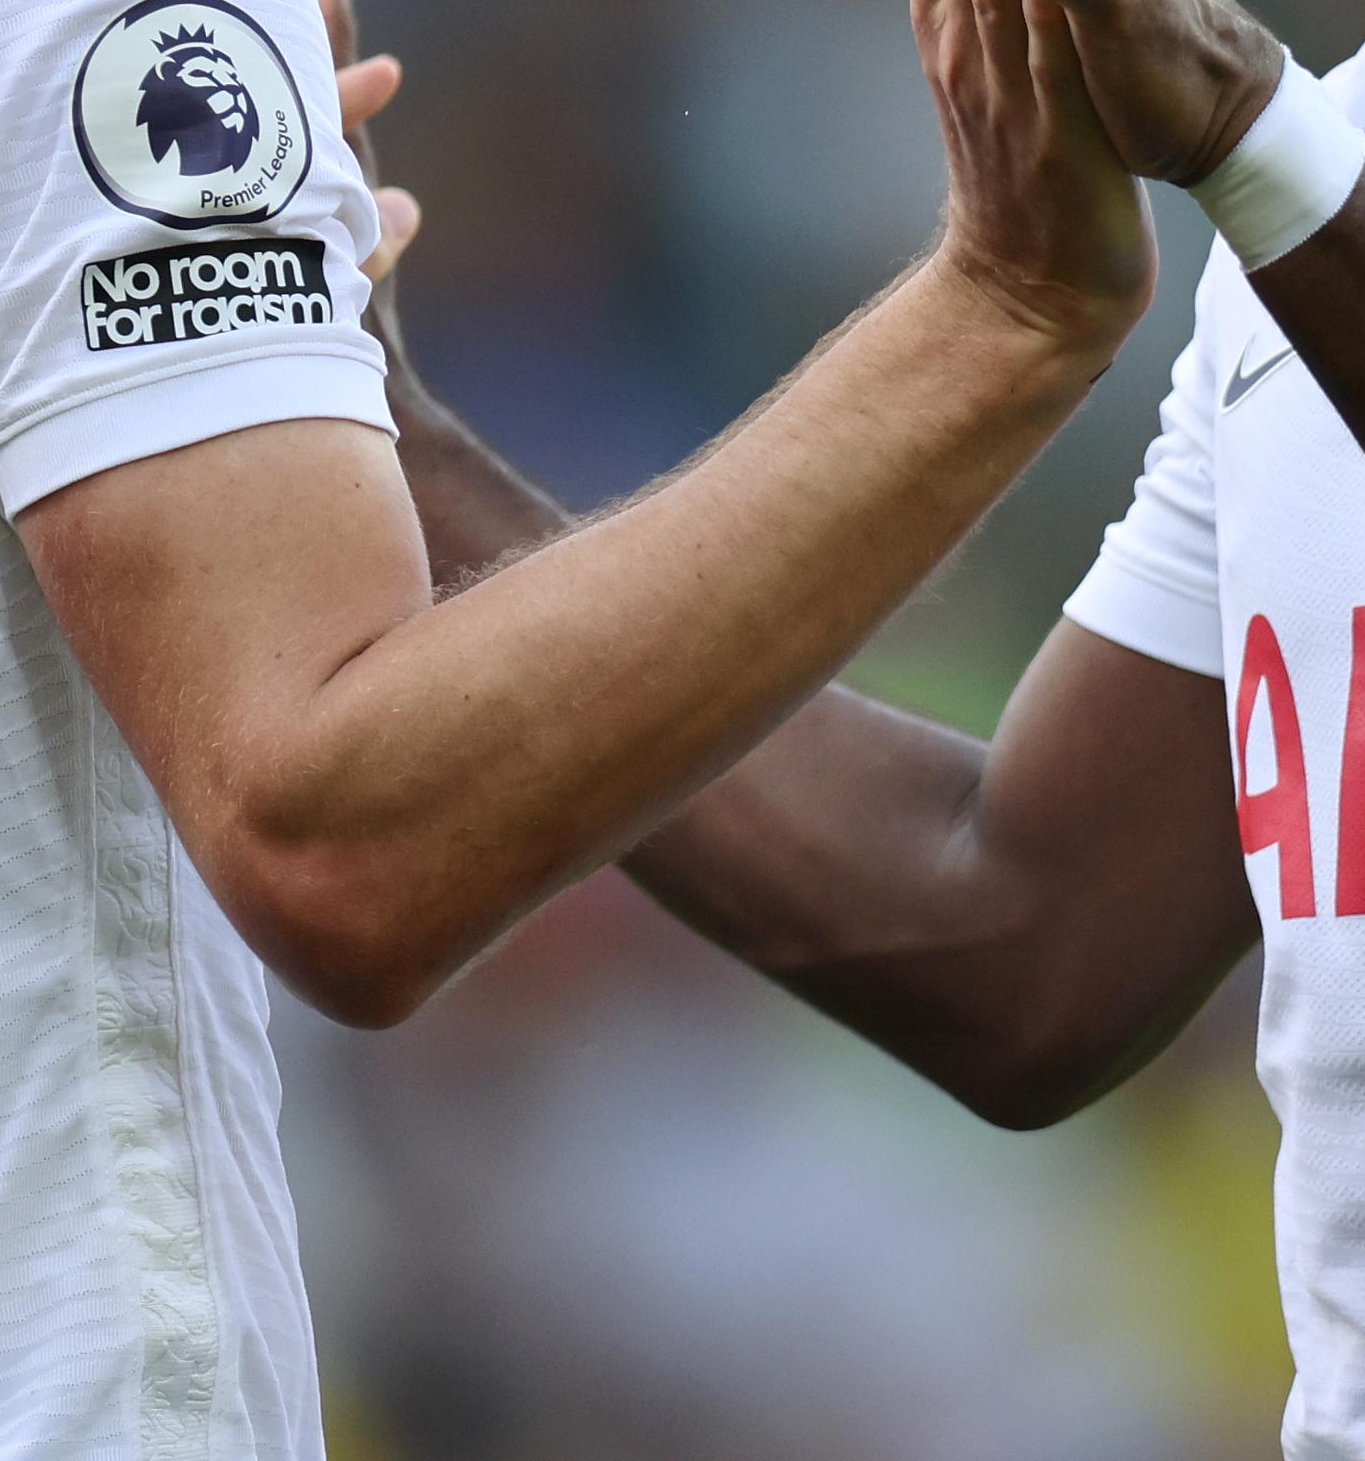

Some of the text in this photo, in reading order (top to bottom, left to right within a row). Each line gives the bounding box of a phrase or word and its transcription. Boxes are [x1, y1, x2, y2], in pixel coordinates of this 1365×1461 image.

[200, 109, 293, 209] Premier League
[84, 250, 306, 306] No room
[85, 292, 332, 349] for racism
